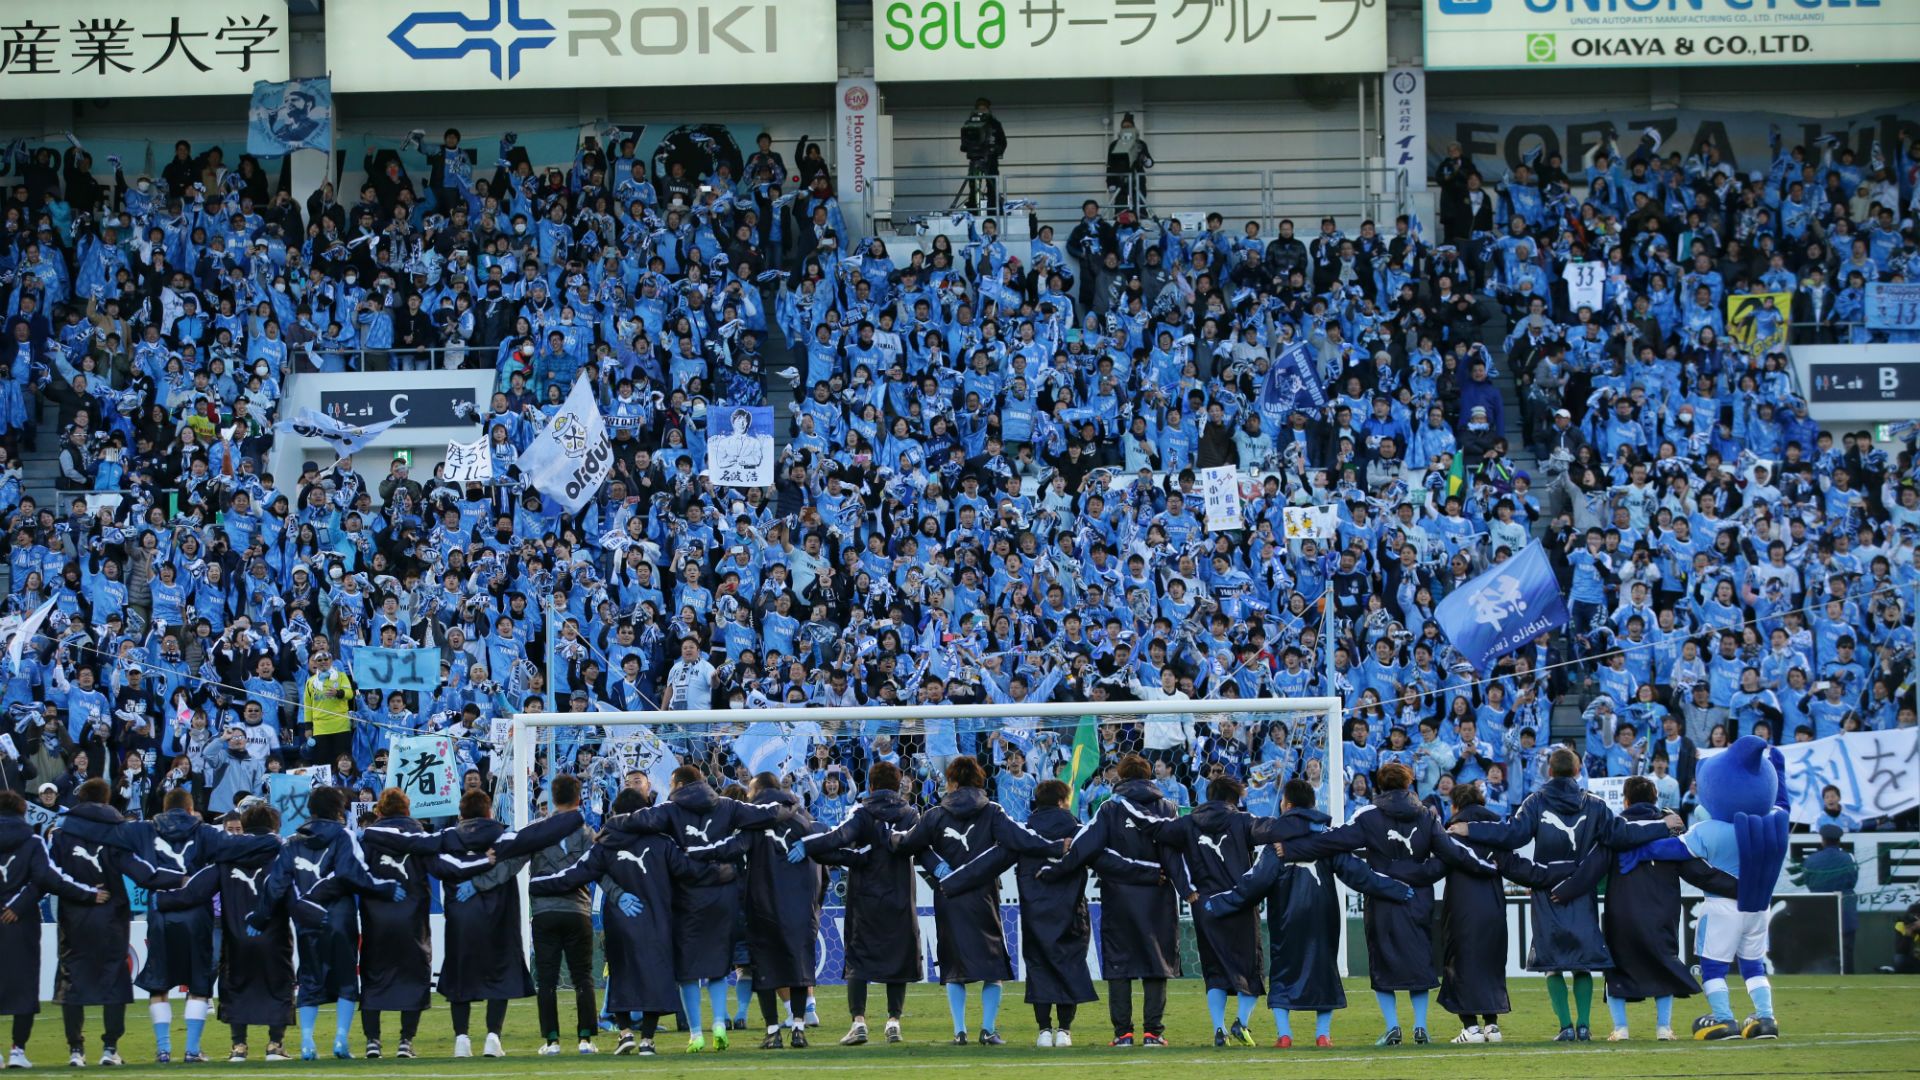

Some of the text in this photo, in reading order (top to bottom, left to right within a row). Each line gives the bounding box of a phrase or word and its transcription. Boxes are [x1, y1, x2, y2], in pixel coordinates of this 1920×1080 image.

[567, 4, 779, 57] ROKI
[0, 14, 281, 76] 産業大学
[1570, 37, 1666, 57] OKAYA
[1674, 36, 1695, 55] &
[1576, 266, 1594, 287] 33
[1878, 367, 1898, 390] B
[389, 394, 409, 418] C
[369, 651, 425, 685] J1
